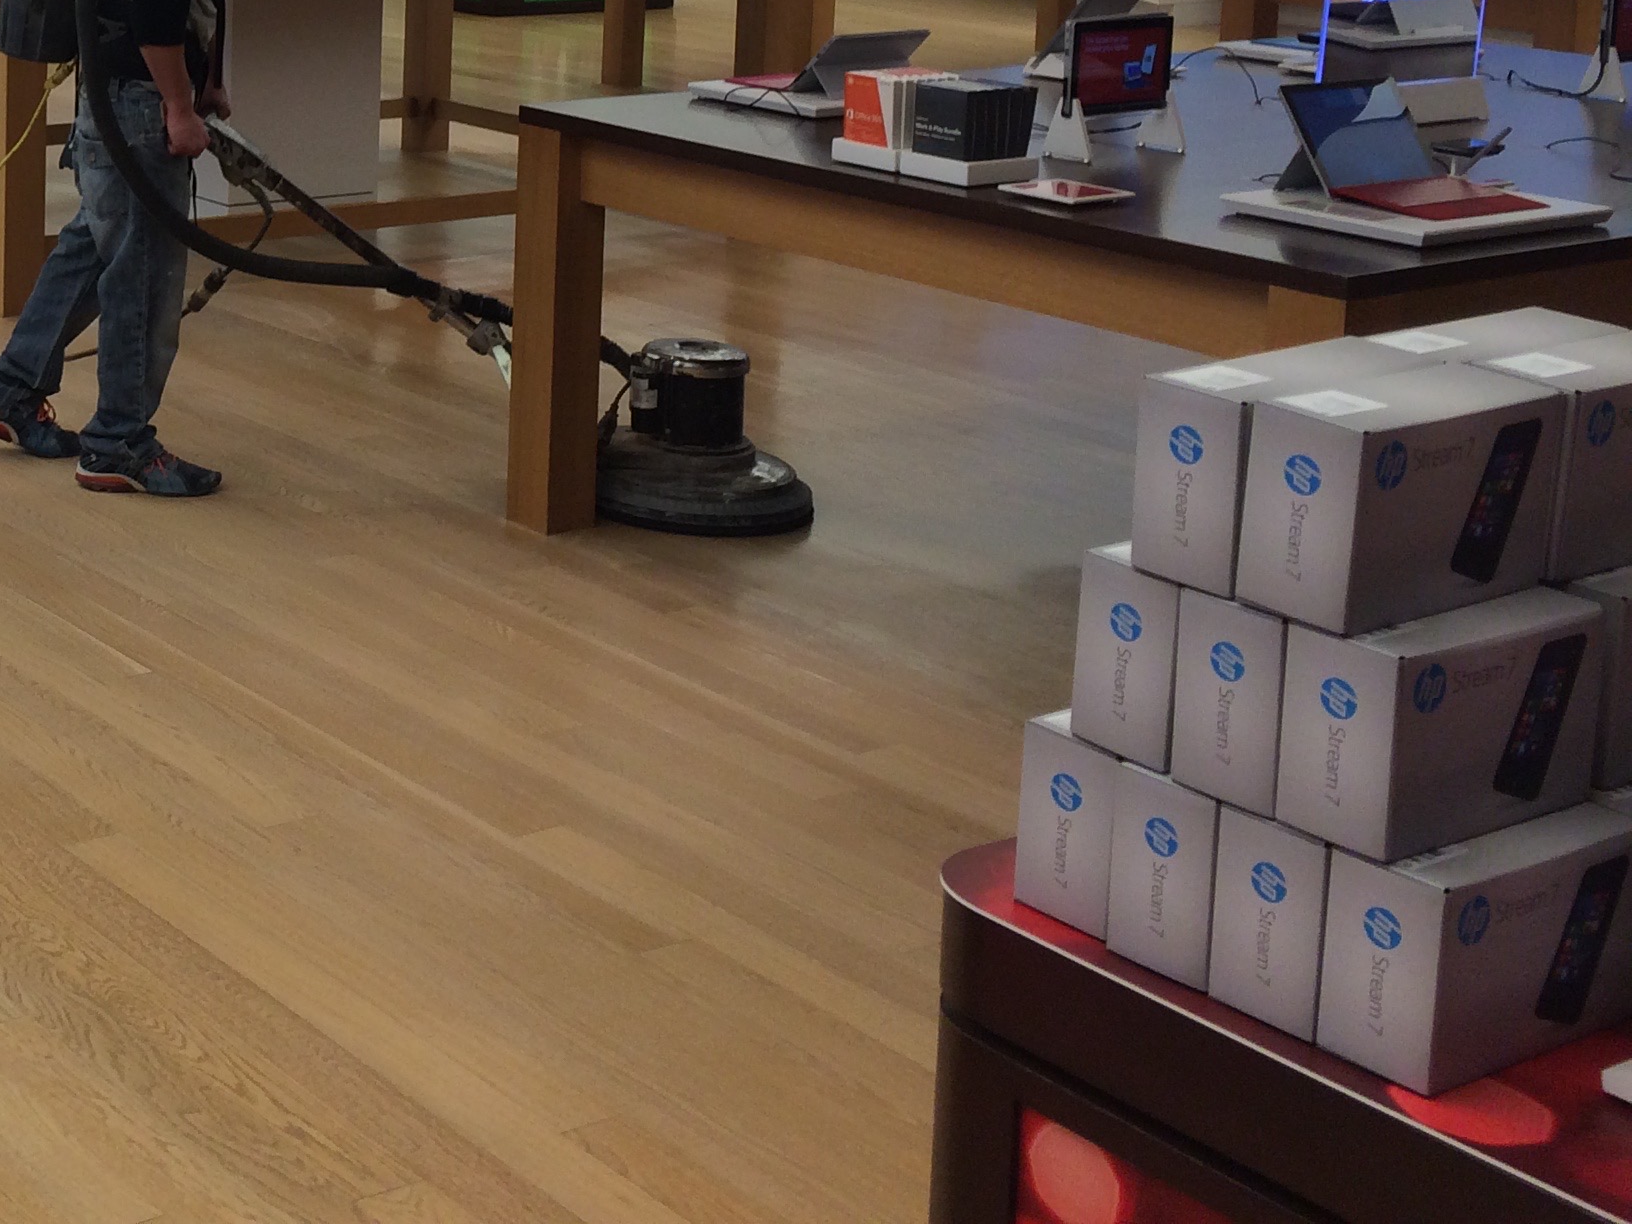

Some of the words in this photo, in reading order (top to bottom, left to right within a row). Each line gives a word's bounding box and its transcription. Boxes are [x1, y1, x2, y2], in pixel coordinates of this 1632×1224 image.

[1169, 424, 1204, 465] hp
[1376, 440, 1408, 492] hp
[1283, 453, 1322, 497] hp
[1175, 469, 1193, 532] Stream
[1174, 534, 1189, 548] 7
[1286, 498, 1309, 565] Stream
[1286, 568, 1302, 582] 7
[1110, 602, 1143, 643] hp
[1112, 646, 1132, 707] Stream
[1210, 641, 1245, 682] hp
[1319, 677, 1359, 721] hp
[1413, 663, 1447, 714] hp
[1452, 665, 1505, 694] Stream
[1112, 709, 1128, 722] 7
[1216, 686, 1235, 750] Stream
[1215, 753, 1231, 767] 7
[1326, 724, 1347, 791] Stream
[1050, 773, 1083, 812] hp
[1325, 794, 1341, 808] 7
[1054, 815, 1072, 875] Stream
[1144, 817, 1179, 858] hp
[1055, 877, 1068, 889] 7
[1150, 861, 1168, 923] Stream
[1251, 861, 1287, 904] hp
[1149, 925, 1164, 938] 7
[1256, 907, 1276, 970] Stream
[1363, 906, 1402, 950] hp
[1457, 895, 1491, 946] hp
[1256, 974, 1271, 987] 7
[1368, 954, 1390, 1020] Stream
[1369, 1023, 1385, 1037] 7
